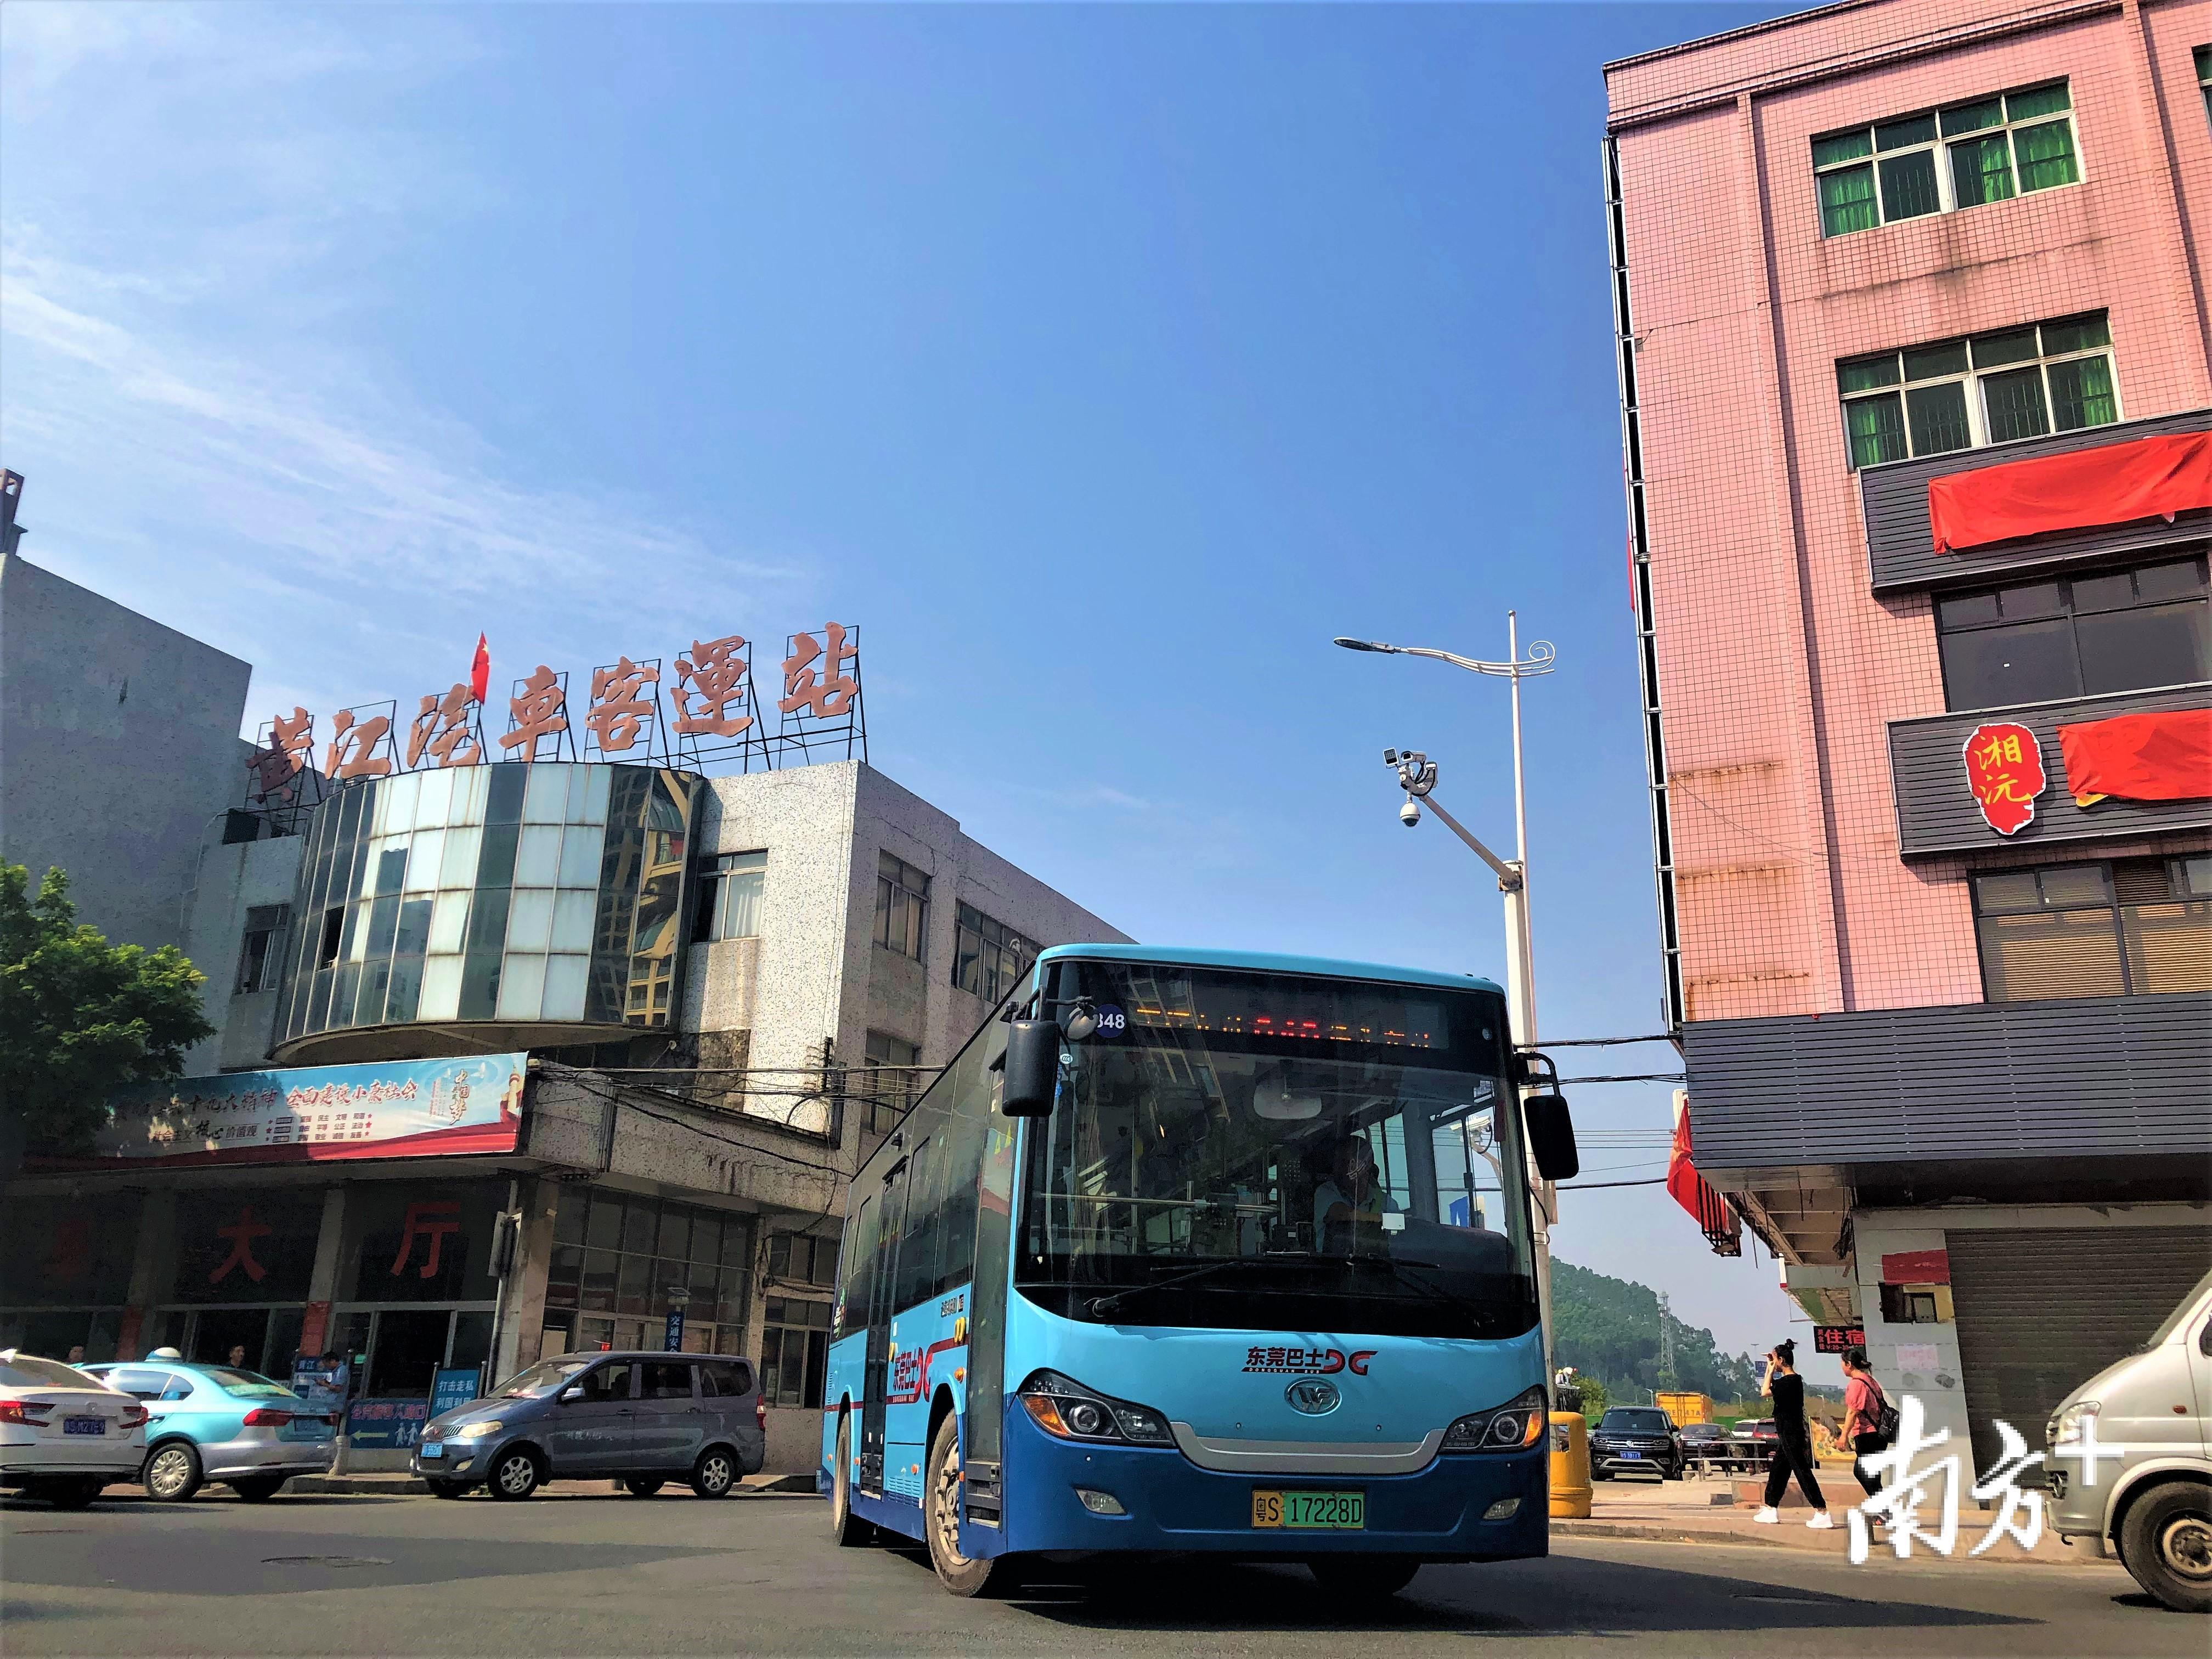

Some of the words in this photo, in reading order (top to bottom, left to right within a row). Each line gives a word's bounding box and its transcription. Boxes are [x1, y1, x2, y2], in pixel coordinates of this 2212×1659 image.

[1975, 734, 2032, 805] 湘沅
[286, 1078, 419, 1107] 全面建设小康社会
[1825, 1329, 1865, 1344] 住宿
[1246, 1346, 1323, 1368] 东莞巴士
[893, 1348, 917, 1392] 东莞巴士
[438, 1380, 473, 1392] 打击走私
[1291, 1498, 1362, 1523] 17228D
